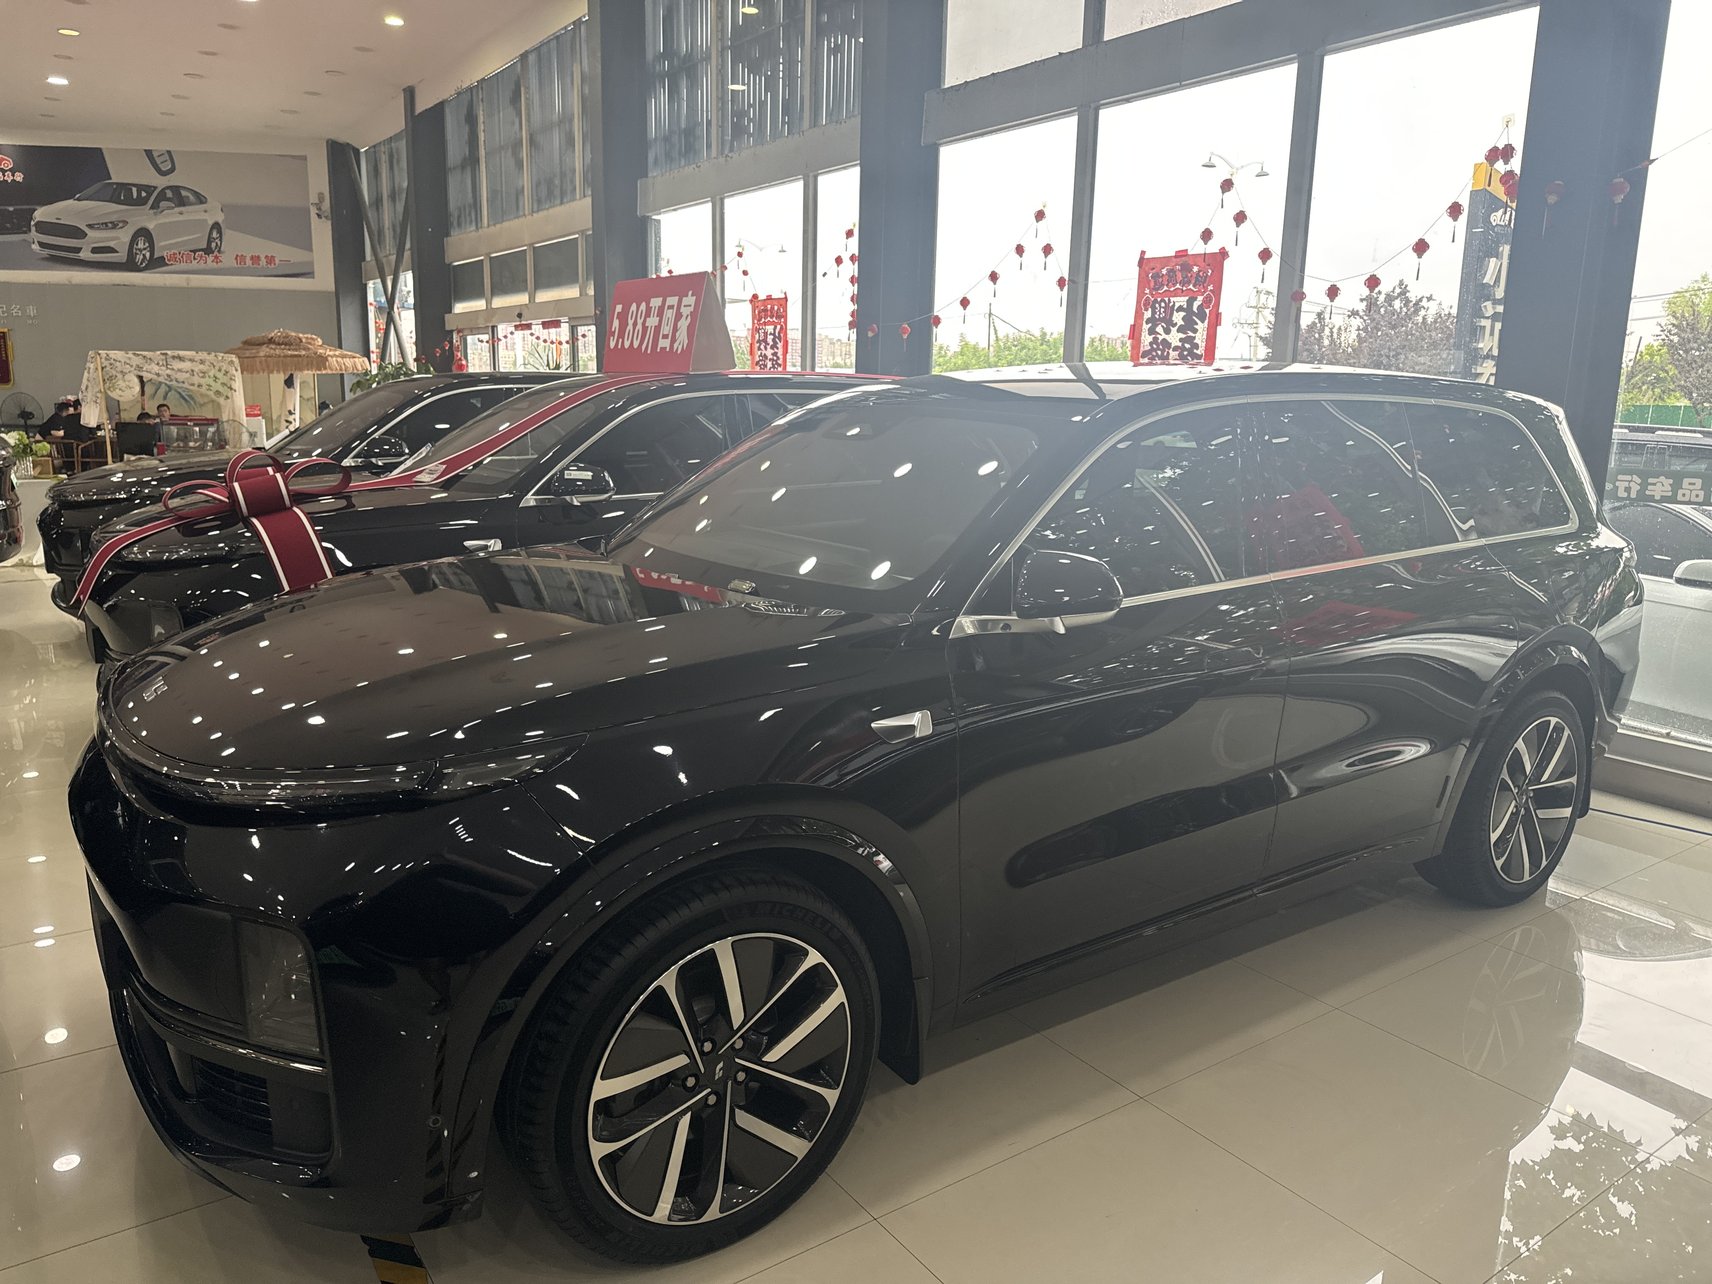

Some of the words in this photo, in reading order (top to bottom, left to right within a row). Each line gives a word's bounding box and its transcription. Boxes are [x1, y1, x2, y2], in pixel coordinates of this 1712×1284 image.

[164, 251, 223, 265] 诚信为本
[234, 254, 292, 267] 信誉第一
[610, 290, 696, 354] 5.88开回家
